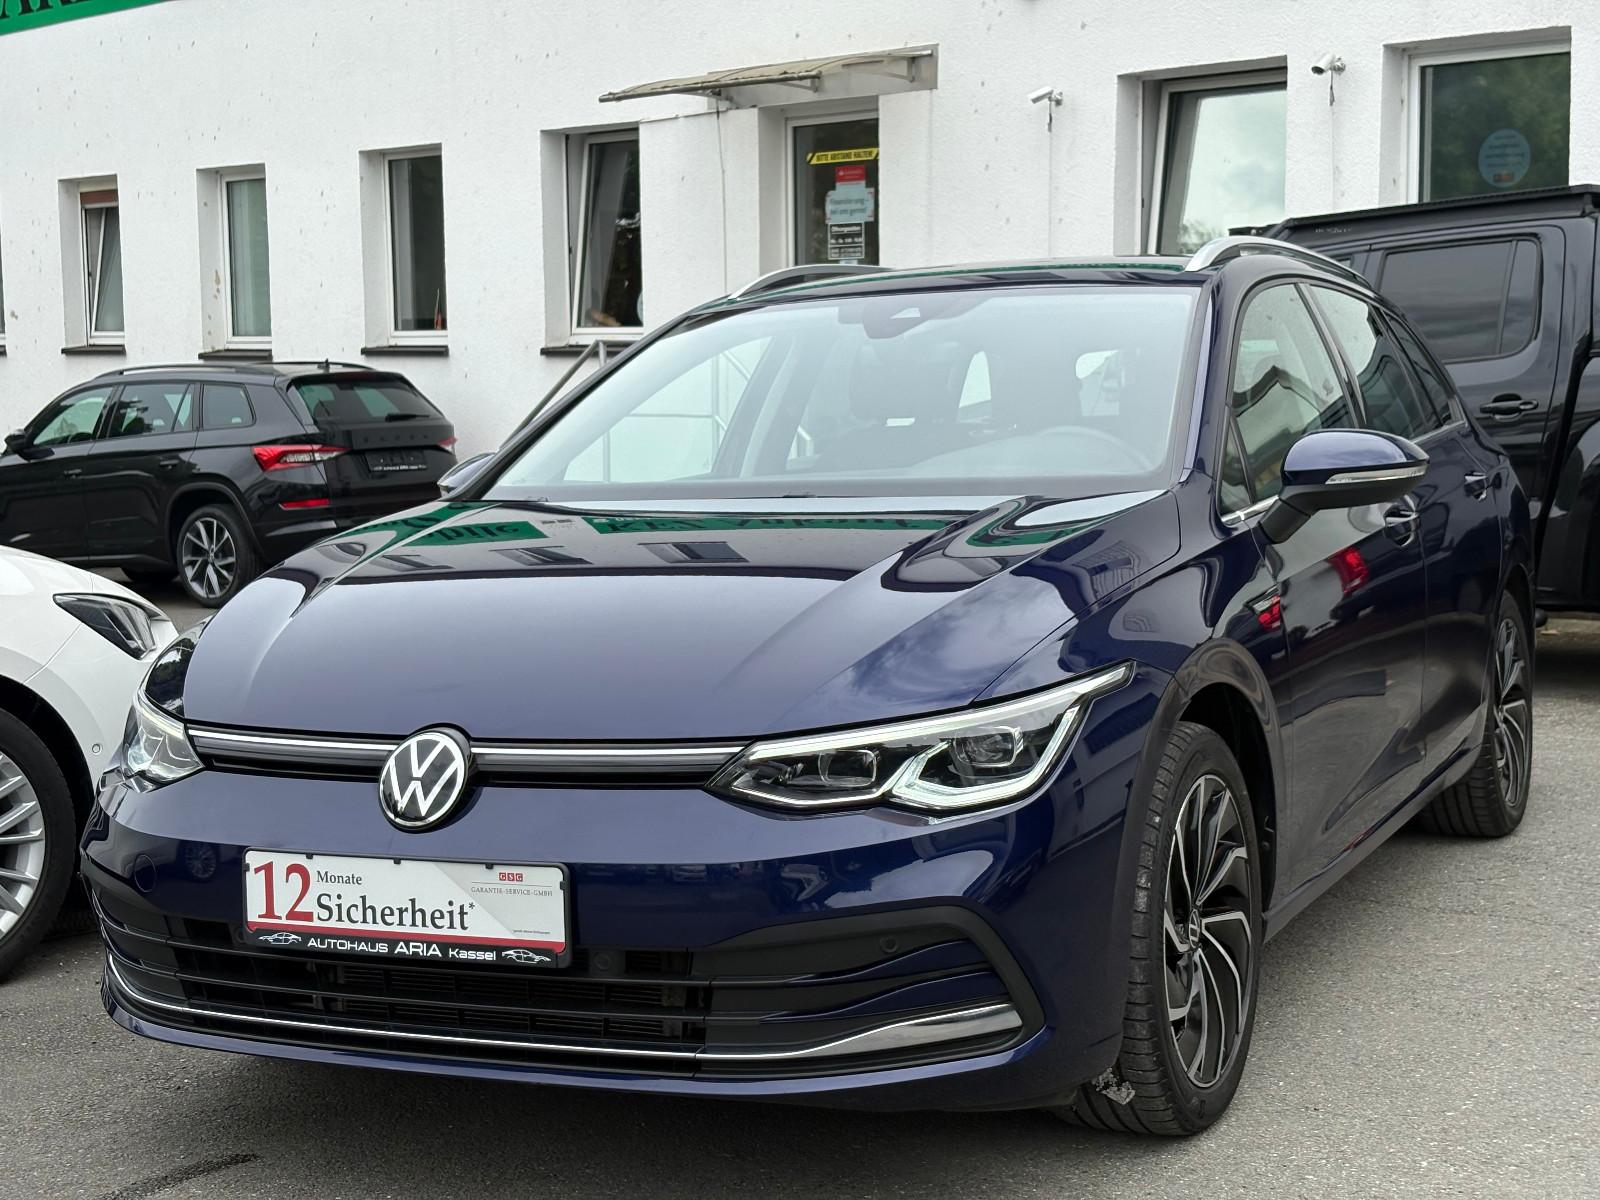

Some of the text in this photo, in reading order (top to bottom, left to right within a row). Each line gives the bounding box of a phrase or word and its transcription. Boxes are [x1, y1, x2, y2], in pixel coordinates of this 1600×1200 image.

[316, 870, 362, 885] Monate
[499, 872, 523, 882] GSG
[253, 860, 314, 922] 12
[307, 938, 497, 961] AUTOHAUS ARIA Kassel
